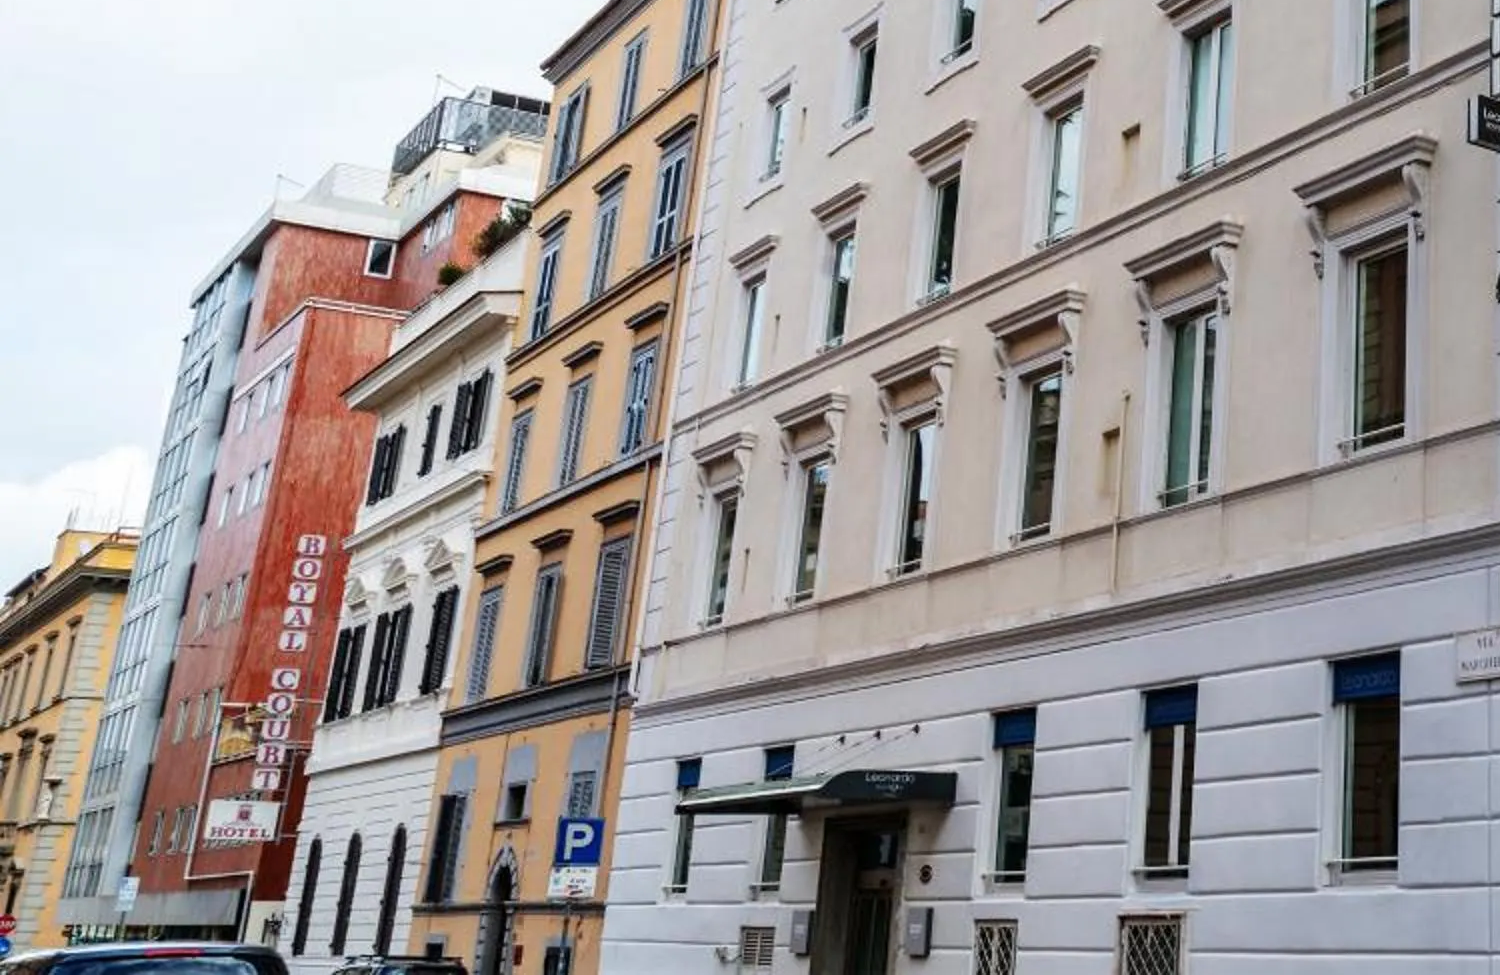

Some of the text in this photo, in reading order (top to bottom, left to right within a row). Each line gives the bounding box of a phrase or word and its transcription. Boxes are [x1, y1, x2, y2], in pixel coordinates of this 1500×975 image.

[255, 535, 322, 789] ROYAL COURT
[210, 825, 271, 839] HOTEL
[564, 822, 595, 861] P
